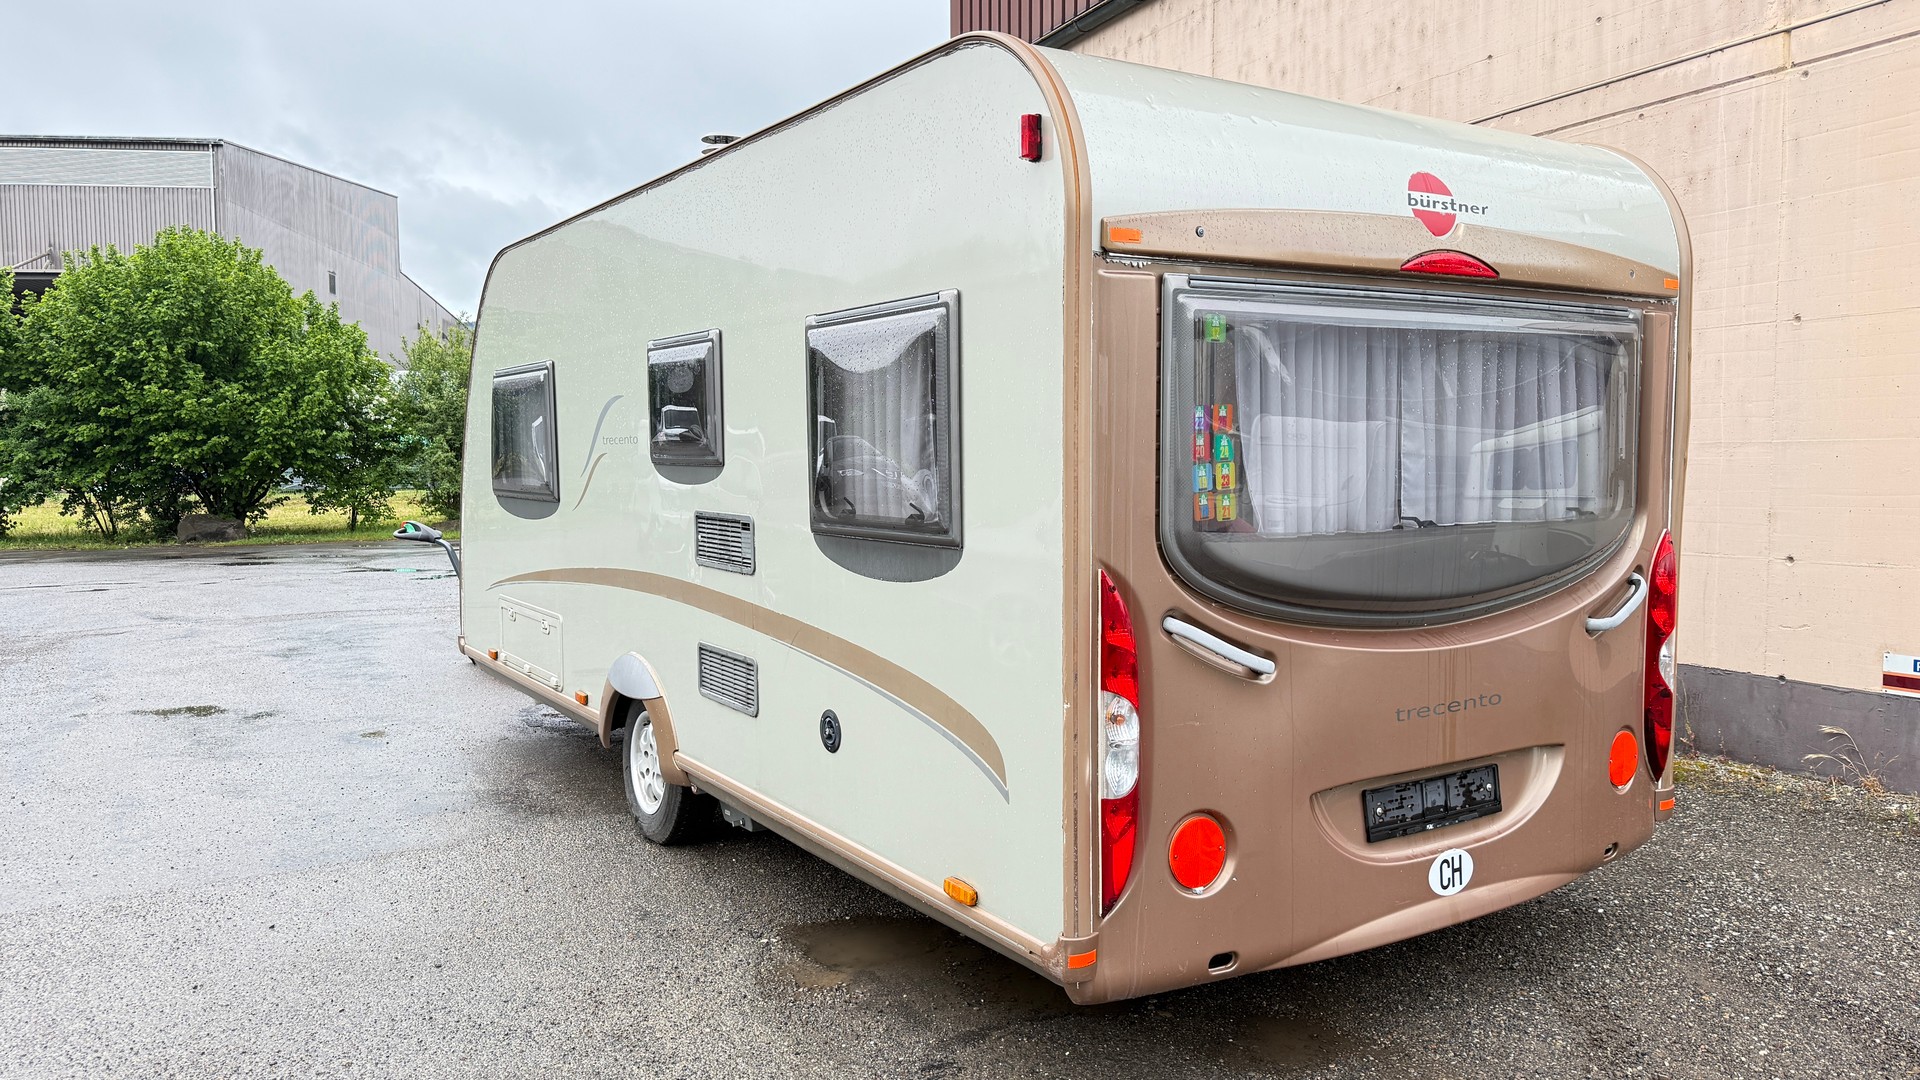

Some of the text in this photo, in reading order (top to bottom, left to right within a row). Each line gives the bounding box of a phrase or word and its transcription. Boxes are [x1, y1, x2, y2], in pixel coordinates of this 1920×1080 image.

[1407, 192, 1489, 215] bürstner
[602, 435, 639, 445] trecento
[1196, 445, 1204, 458] 20
[1220, 445, 1229, 458] 24
[1221, 474, 1230, 487] 23
[1222, 506, 1231, 518] 21
[1394, 693, 1502, 722] trecento
[1439, 854, 1463, 891] CH
